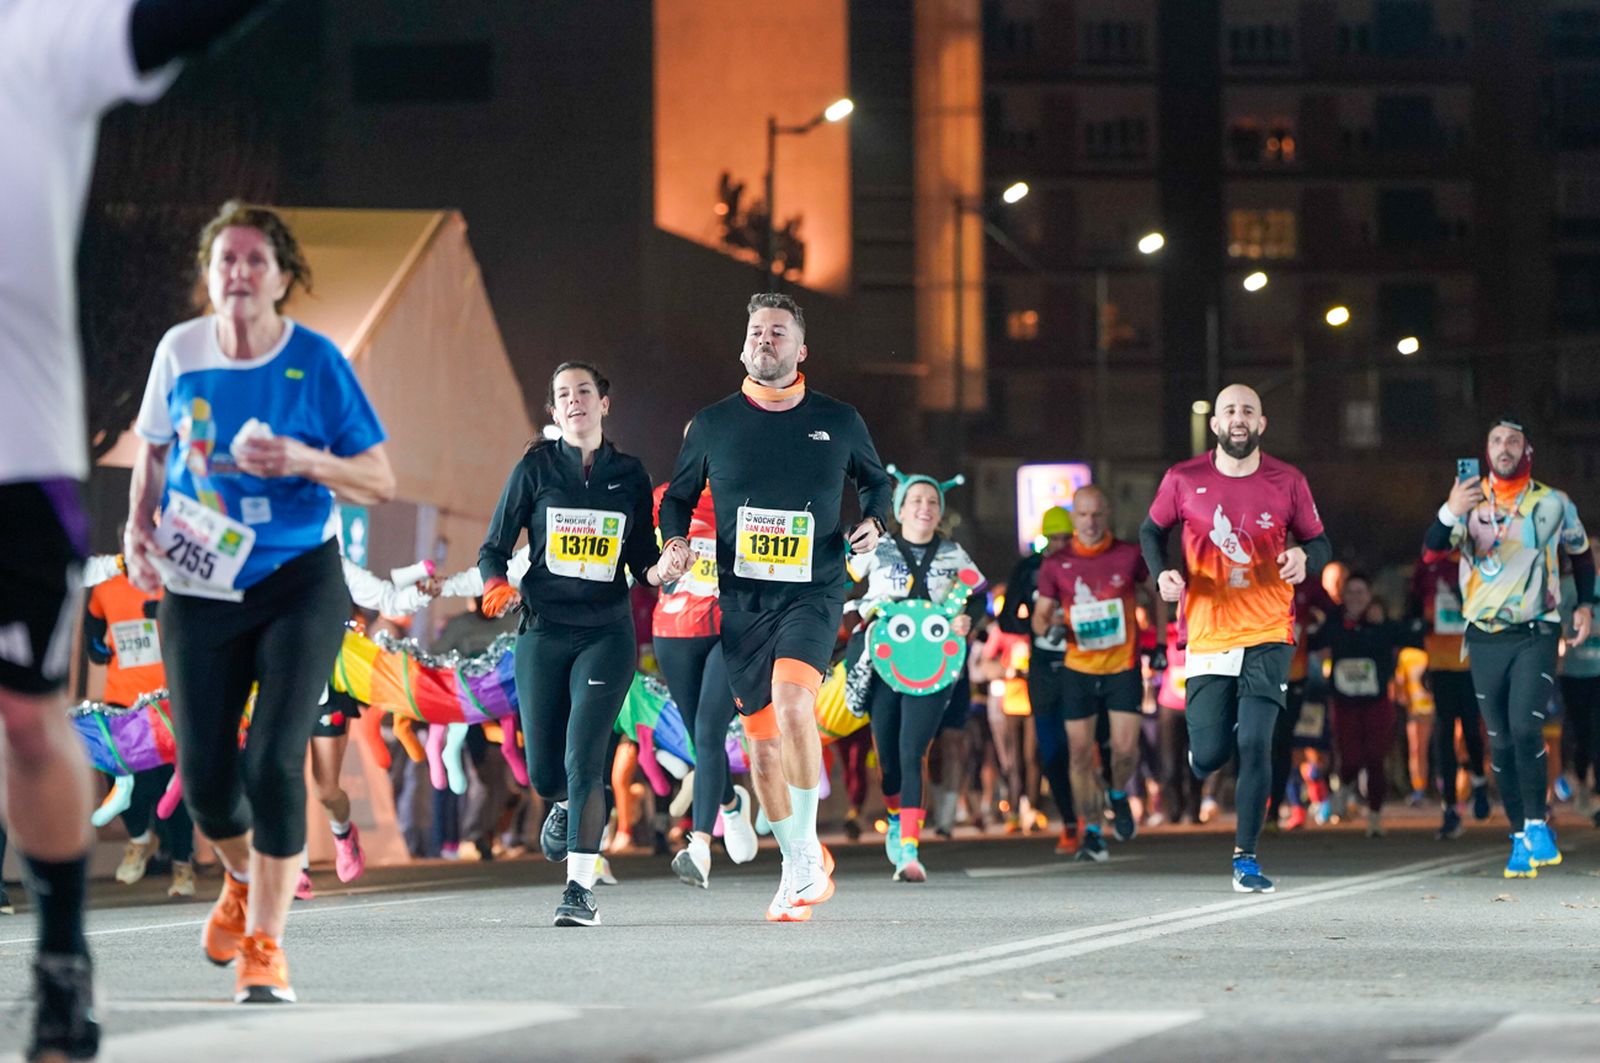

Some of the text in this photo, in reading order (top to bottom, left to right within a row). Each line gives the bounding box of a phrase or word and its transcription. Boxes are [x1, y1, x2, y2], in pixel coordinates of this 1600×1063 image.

[564, 517, 586, 525] NOCHE
[745, 523, 759, 532] SAN
[752, 516, 786, 526] NOCHE DE
[556, 525, 571, 533] SAN
[560, 535, 610, 557] 13116
[749, 534, 800, 557] 13117
[1222, 538, 1238, 554] 43
[166, 532, 218, 580] 2155
